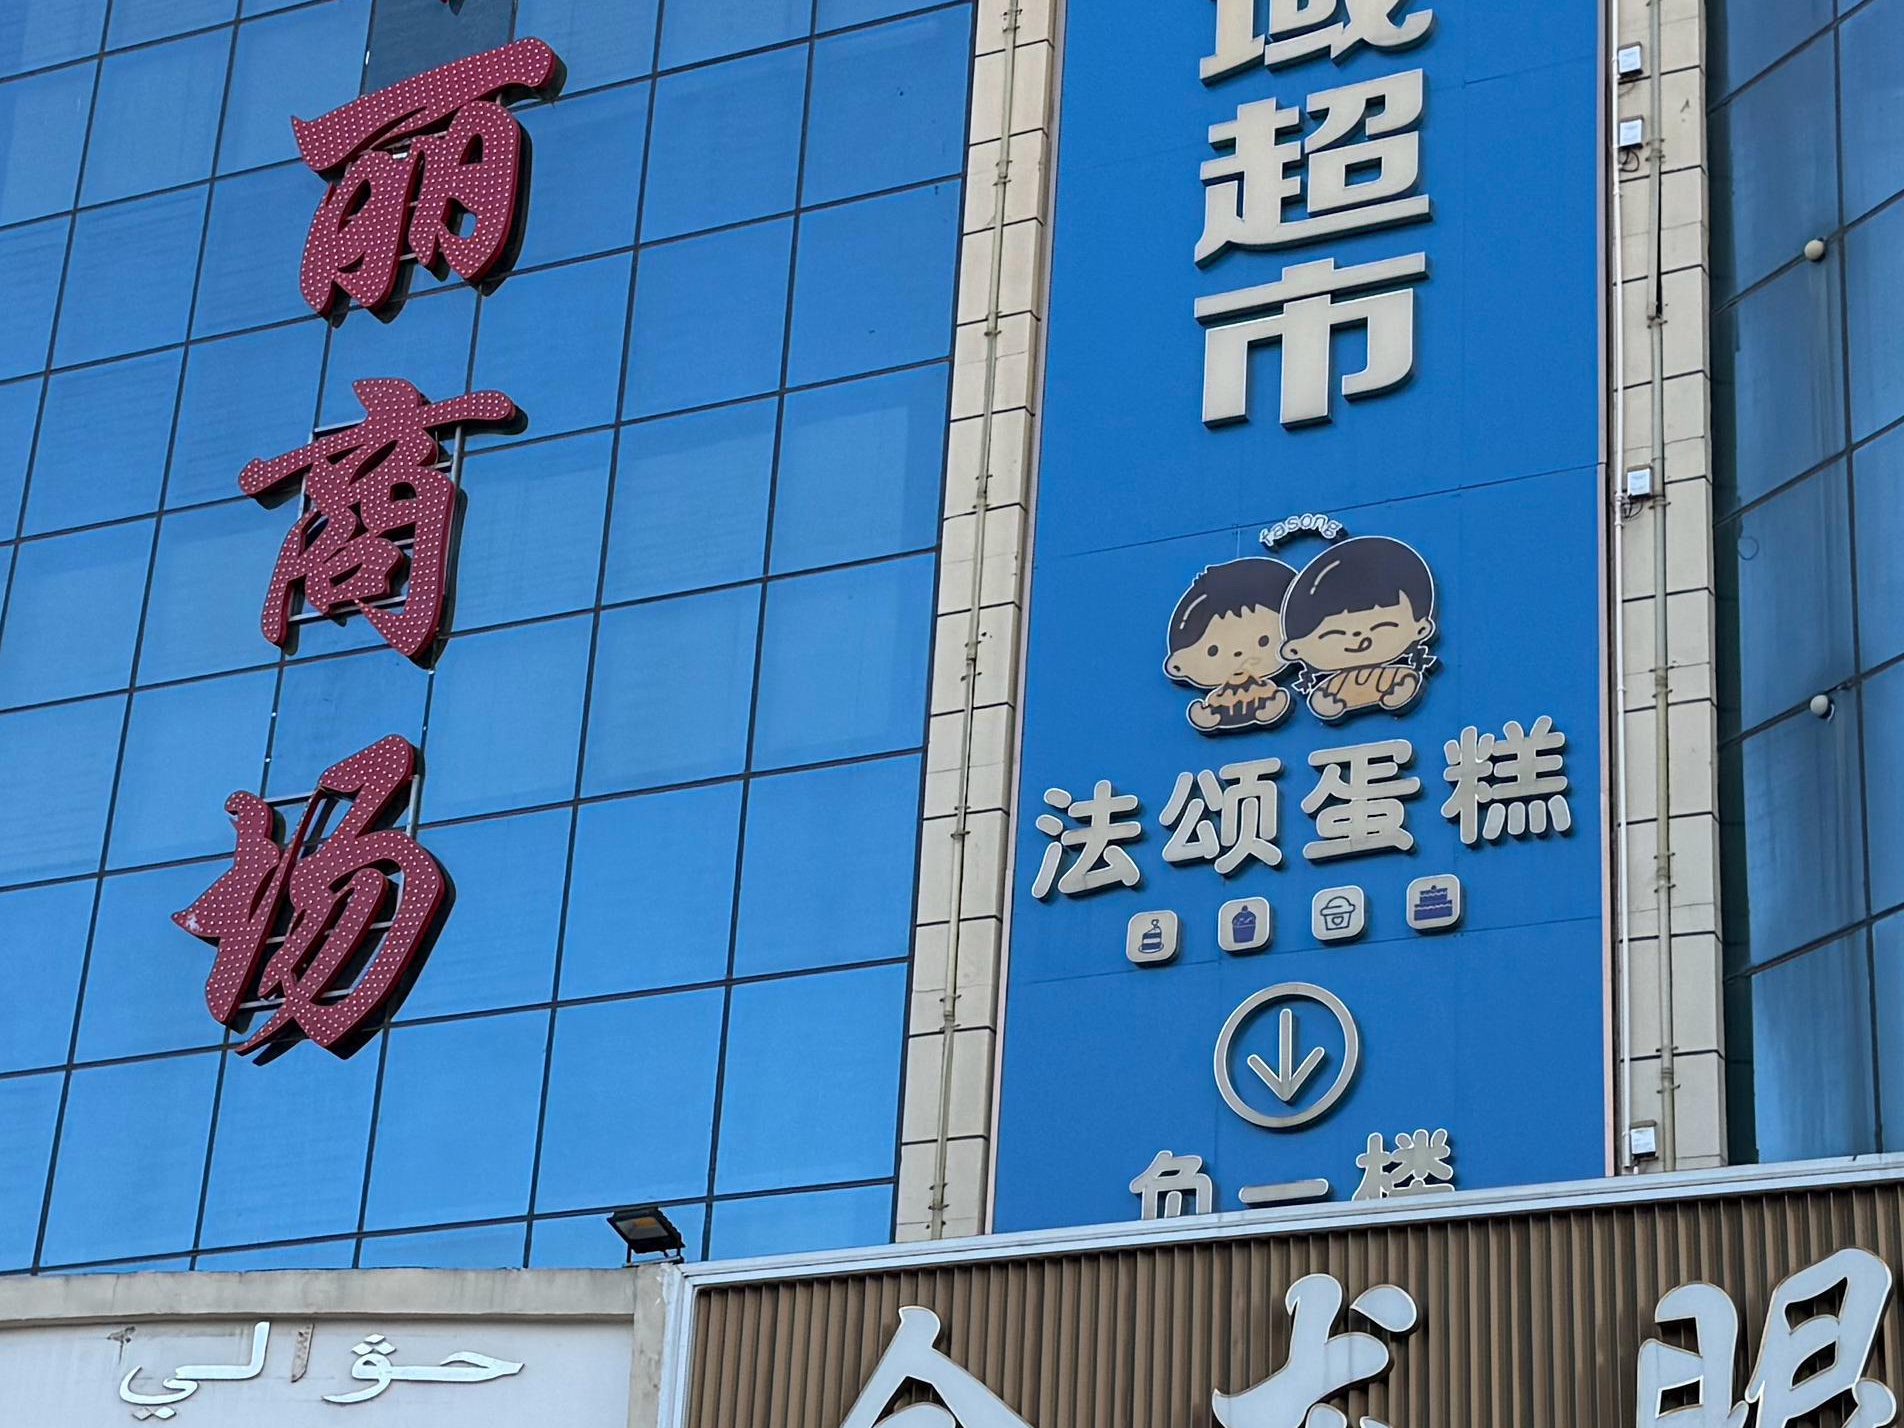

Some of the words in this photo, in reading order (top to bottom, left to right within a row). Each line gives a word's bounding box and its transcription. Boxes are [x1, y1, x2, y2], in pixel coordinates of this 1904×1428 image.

[1259, 513, 1342, 547] fasong
[1031, 714, 1571, 900] 法颂蛋糕
